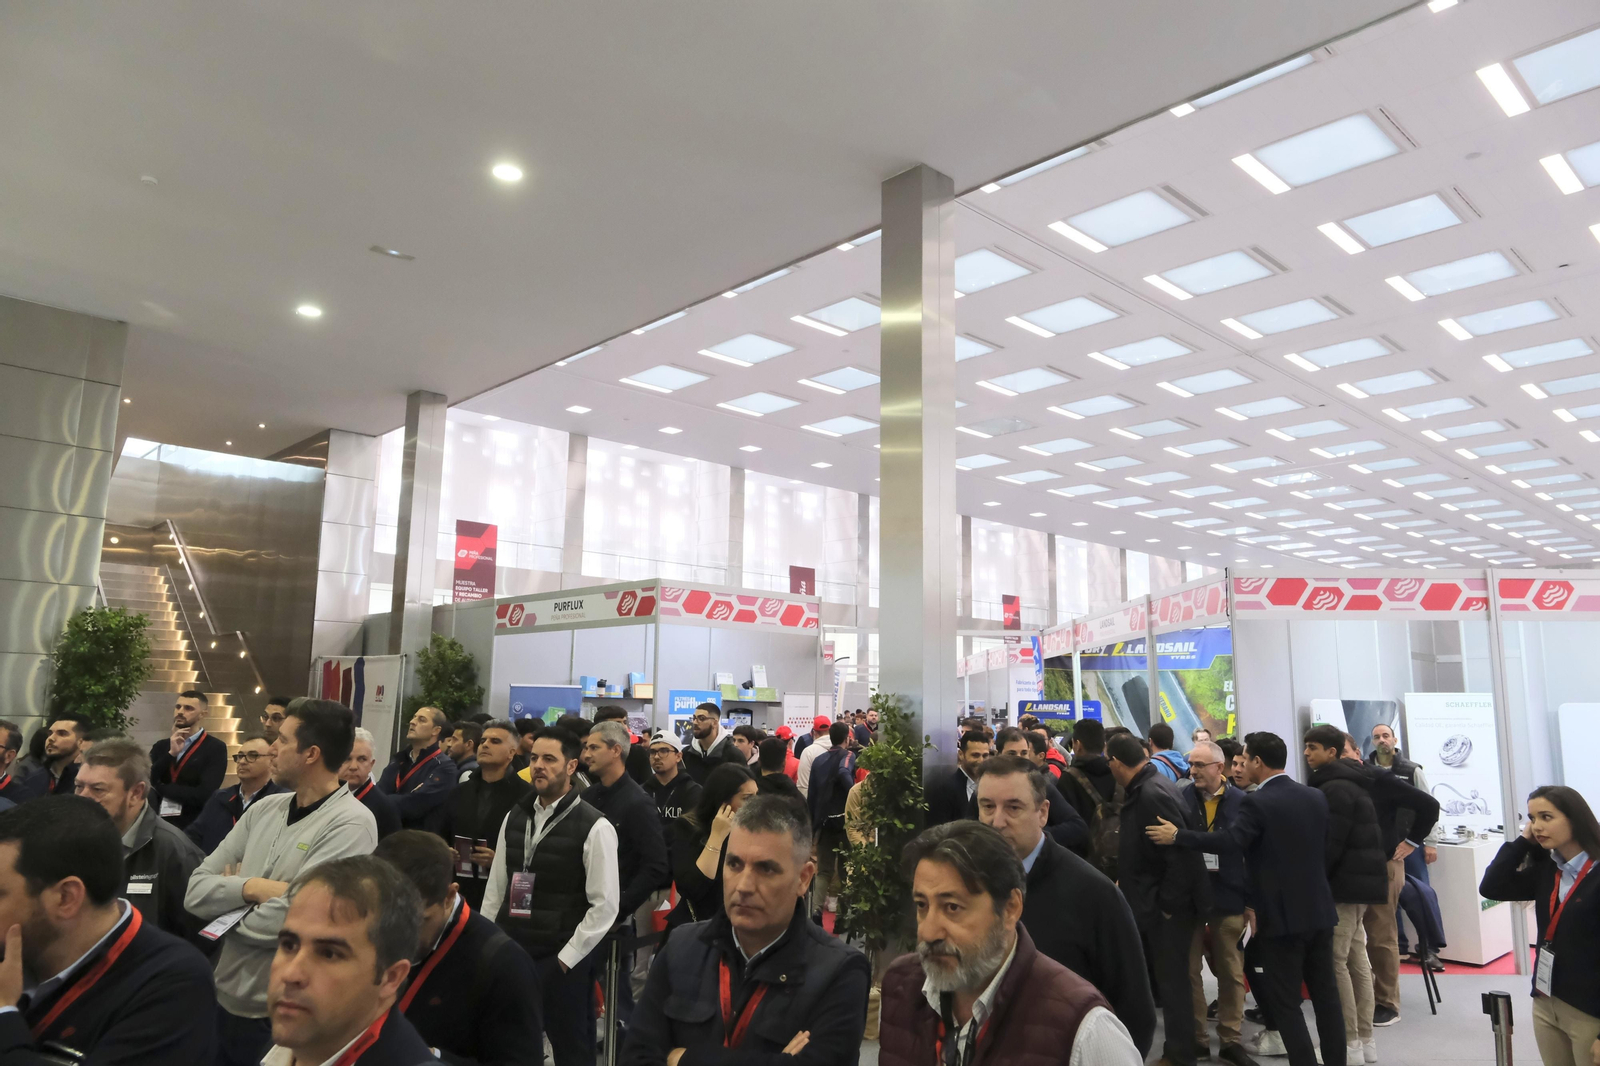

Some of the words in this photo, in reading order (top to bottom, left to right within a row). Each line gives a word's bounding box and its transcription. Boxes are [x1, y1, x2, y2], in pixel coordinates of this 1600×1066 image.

[553, 599, 584, 612] PURFLUX
[1126, 641, 1197, 654] LADSAIL
[1032, 703, 1071, 711] LANDSAIL
